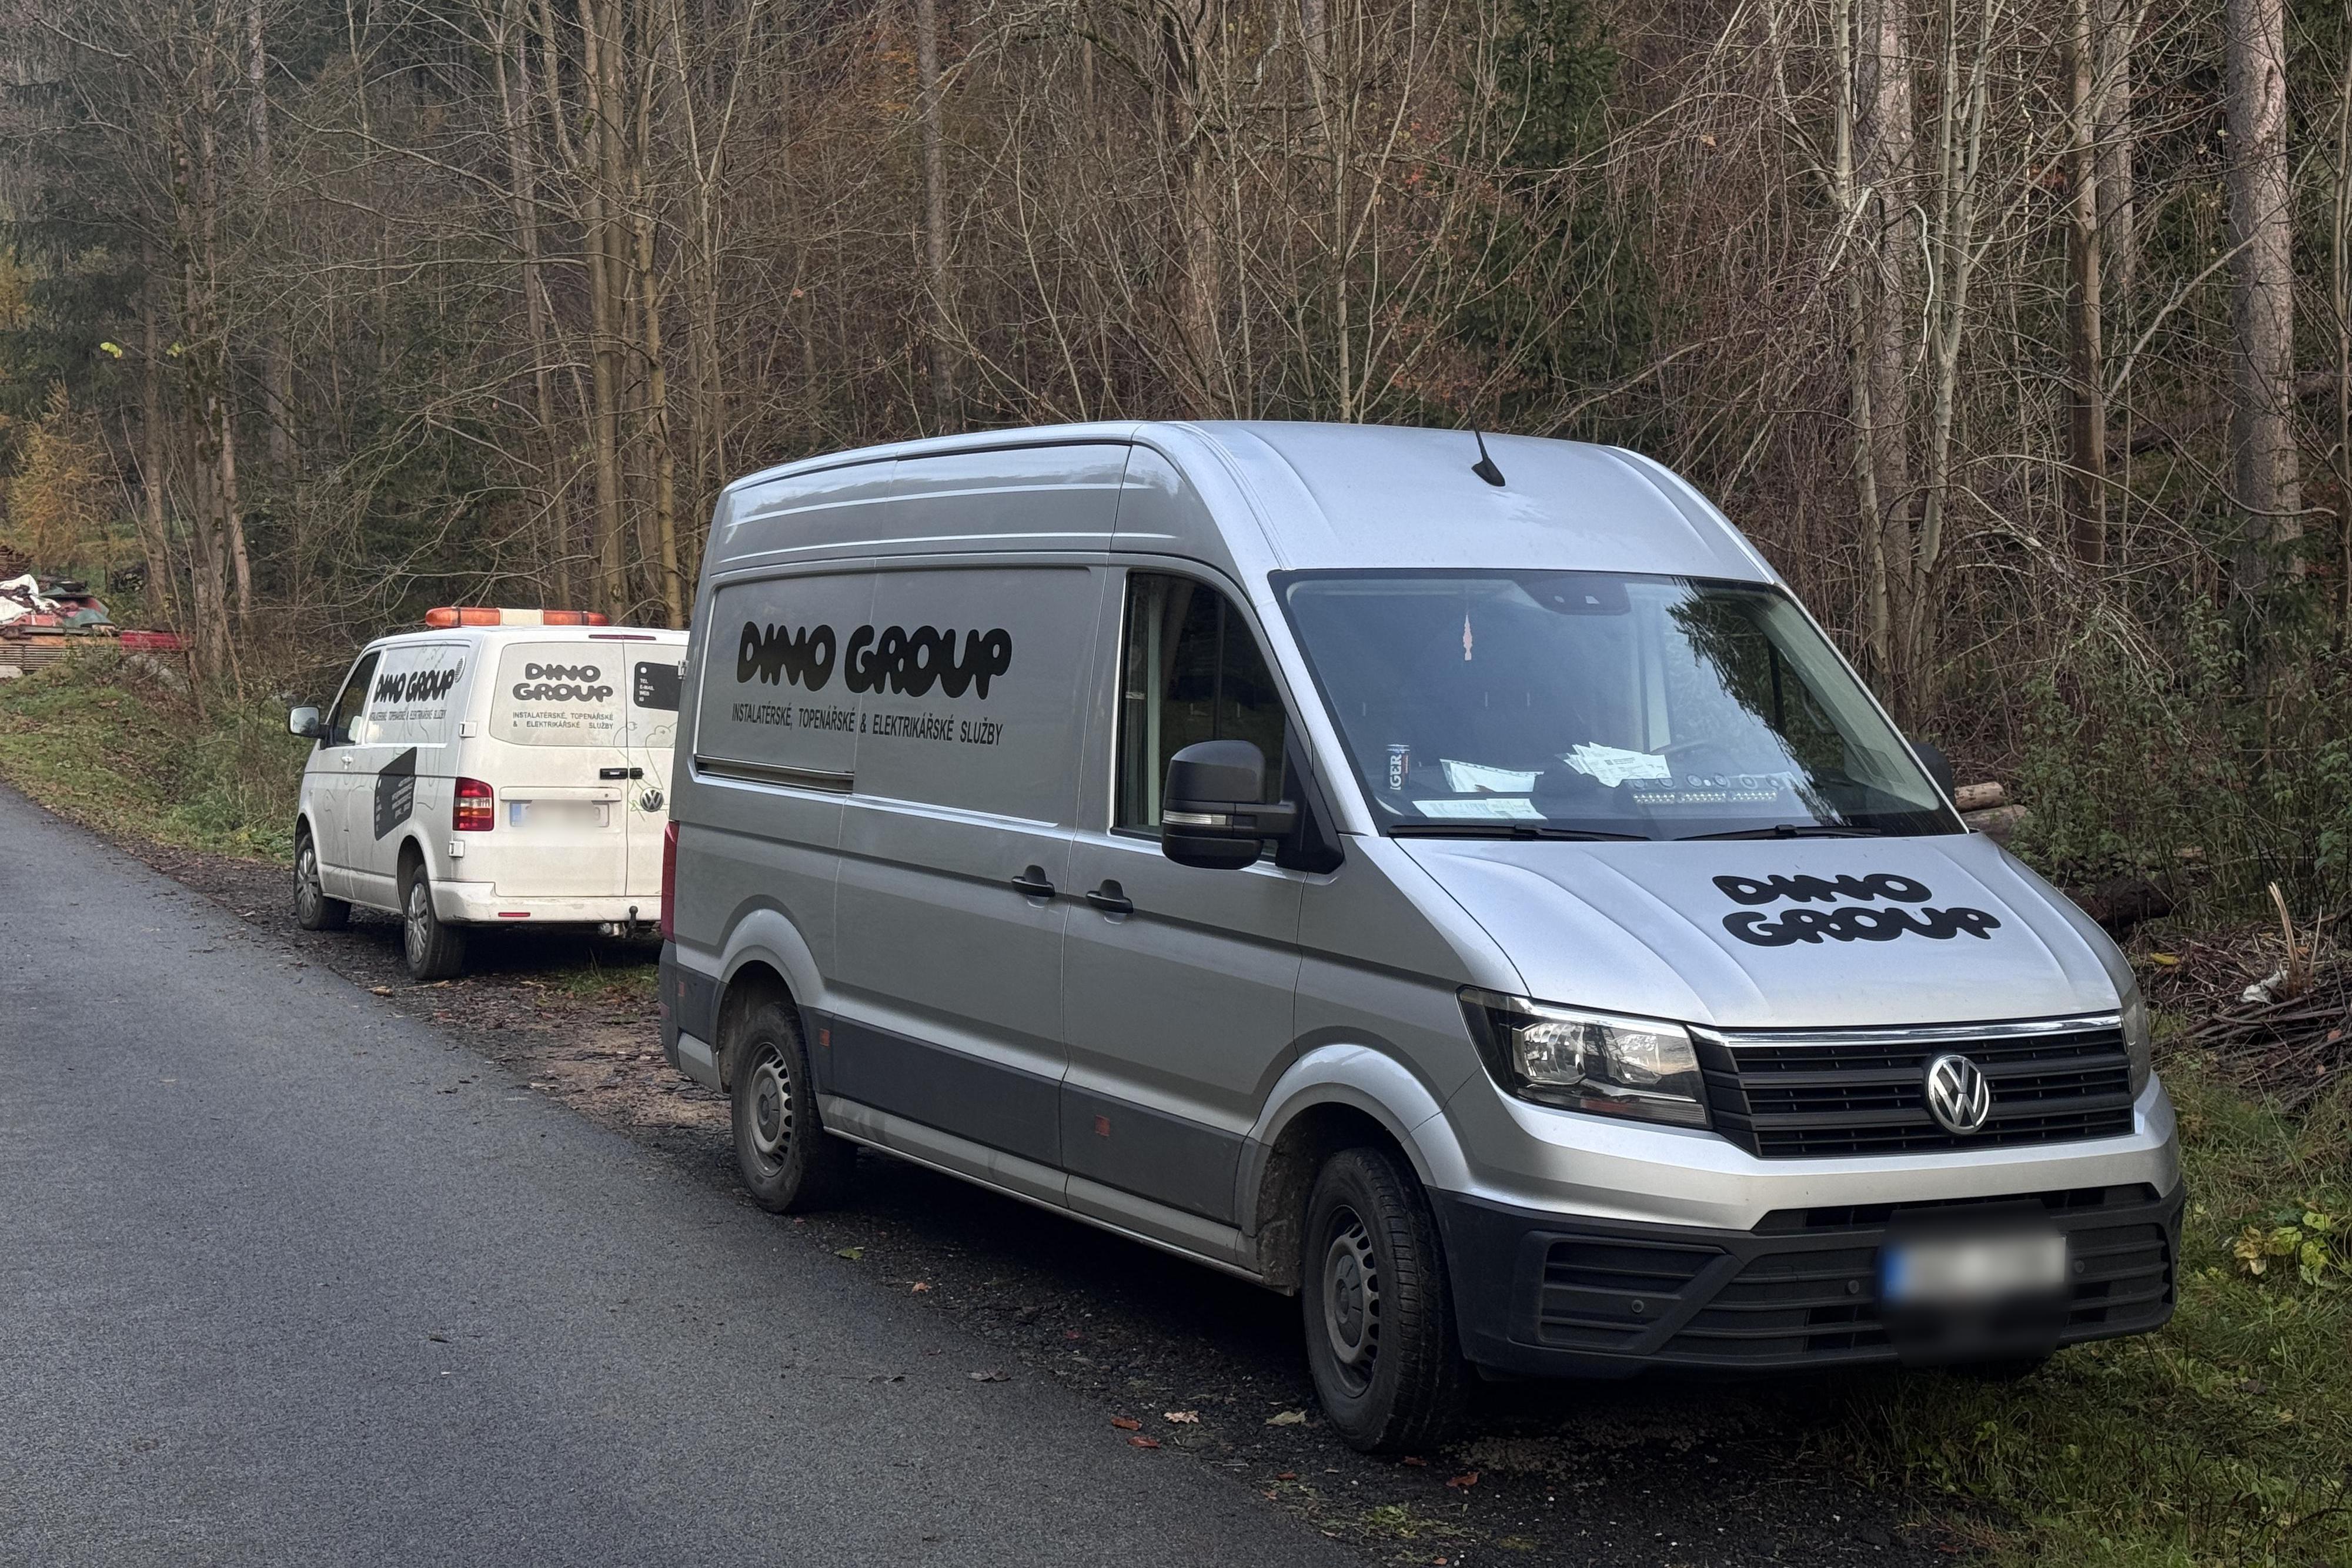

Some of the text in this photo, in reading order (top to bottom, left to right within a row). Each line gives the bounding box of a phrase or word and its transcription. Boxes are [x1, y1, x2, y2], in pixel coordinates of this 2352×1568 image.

[526, 663, 601, 683] DINO
[737, 621, 1012, 700] DINO GROUP
[373, 669, 455, 704] DINO GROUP
[513, 683, 613, 703] GROUP
[731, 701, 1003, 746] INSTALATÉRSKÉ, TOPENÁŘSKÉ & ELEKTRIKÁŘSKÉ SLUŽBY
[1389, 754, 1402, 790] IGER
[1712, 874, 1932, 905] DINO
[1722, 907, 2002, 947] GROUP
